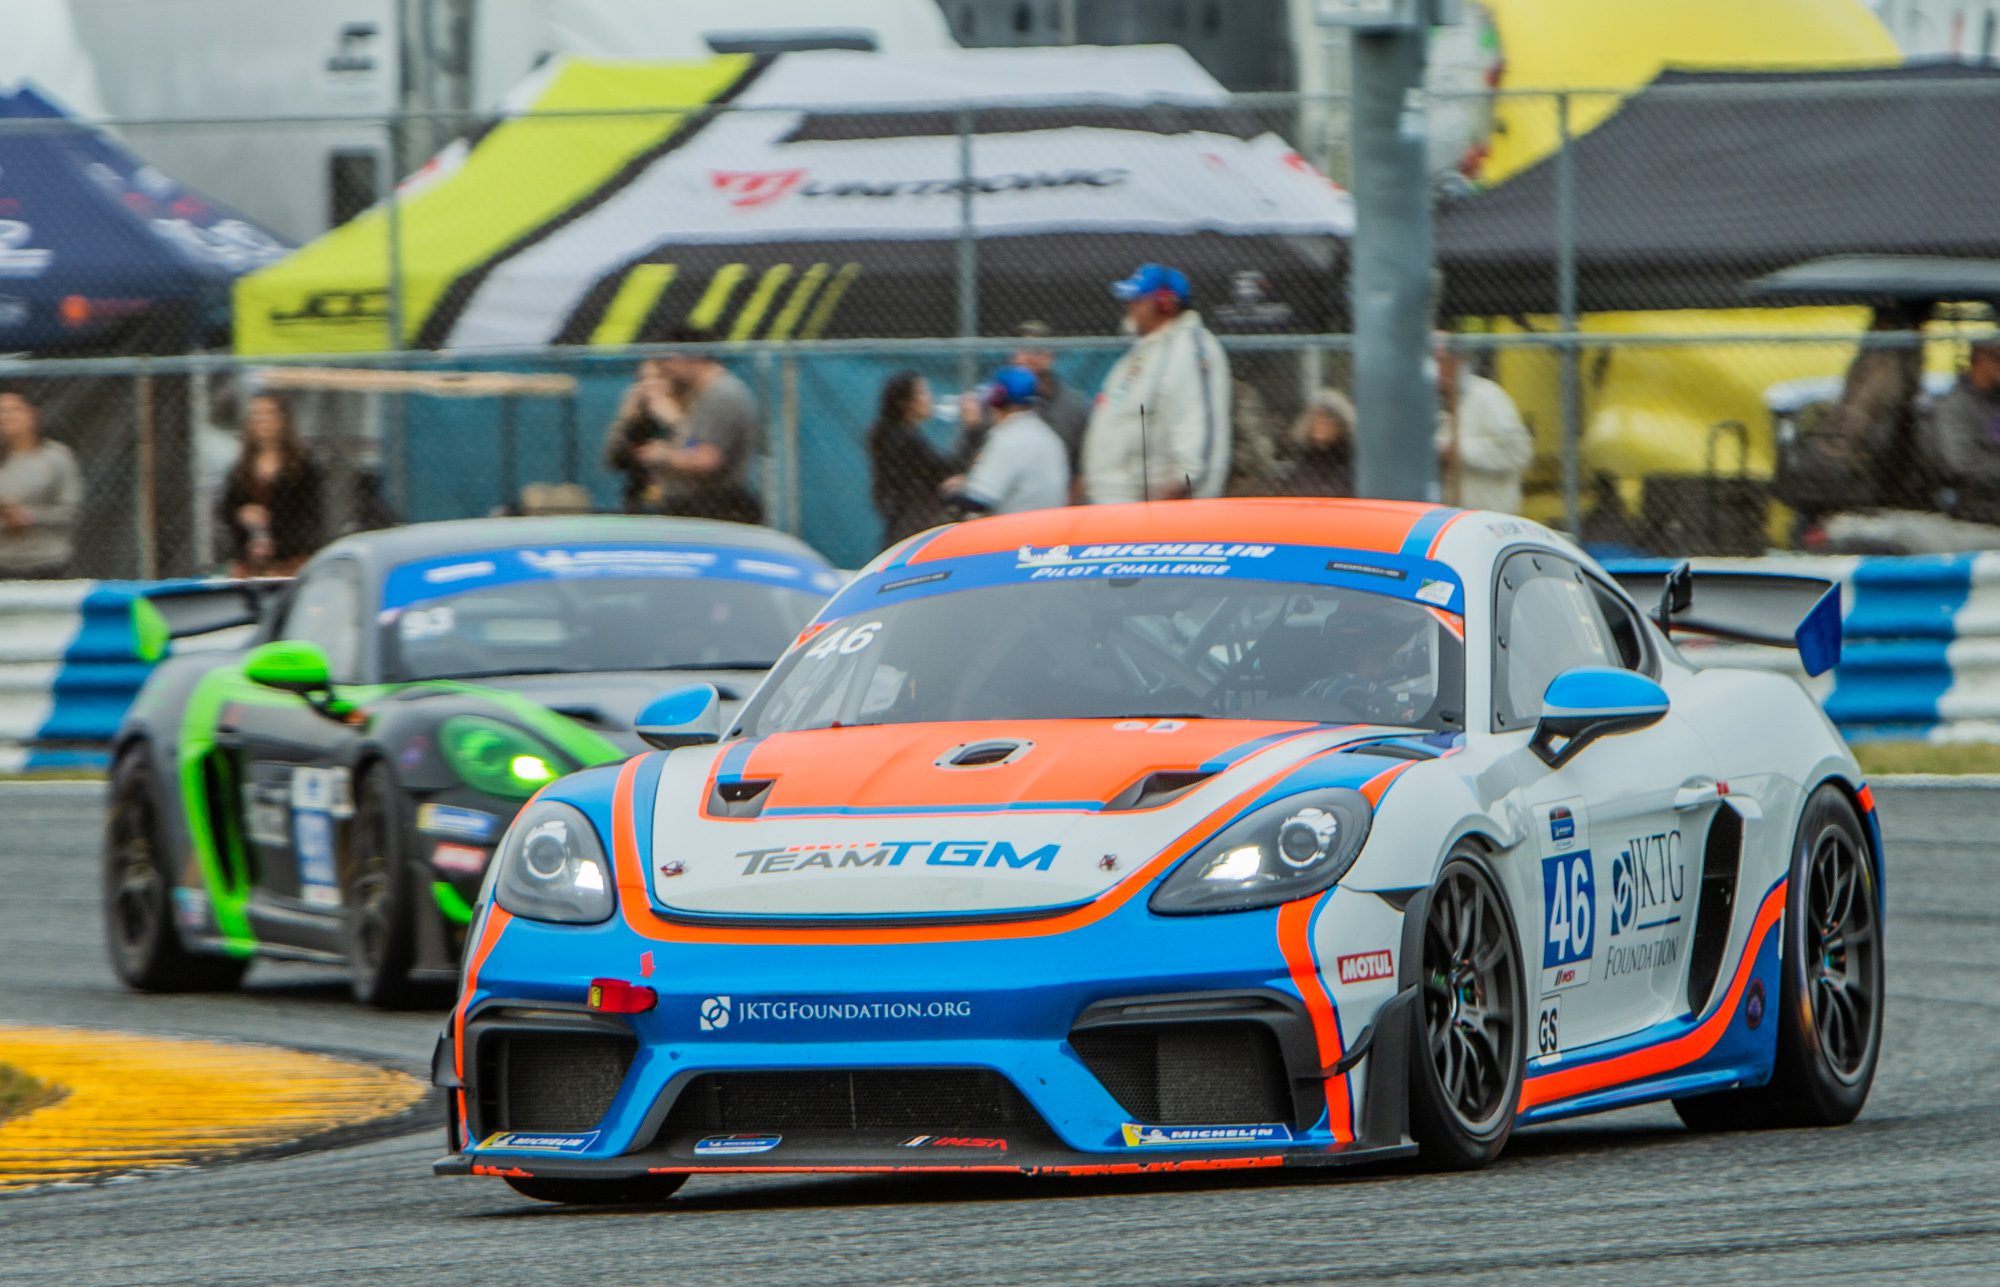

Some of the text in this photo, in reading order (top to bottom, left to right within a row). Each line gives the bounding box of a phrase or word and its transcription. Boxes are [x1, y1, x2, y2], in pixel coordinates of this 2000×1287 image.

[1079, 543, 1276, 559] MICHELIN
[1030, 563, 1232, 580] PILOT CHALLENGE
[804, 620, 884, 661] 46
[1628, 829, 1685, 930] JKTG
[1548, 856, 1591, 961] 46
[1342, 952, 1392, 981] MOTUL
[1604, 936, 1680, 980] FOUNDATION
[738, 1001, 972, 1023] JKTGFOUNDATION.ORG
[1538, 1007, 1558, 1055] GS
[513, 1136, 585, 1147] MICHELIN
[1170, 1127, 1274, 1139] MICHELIN
